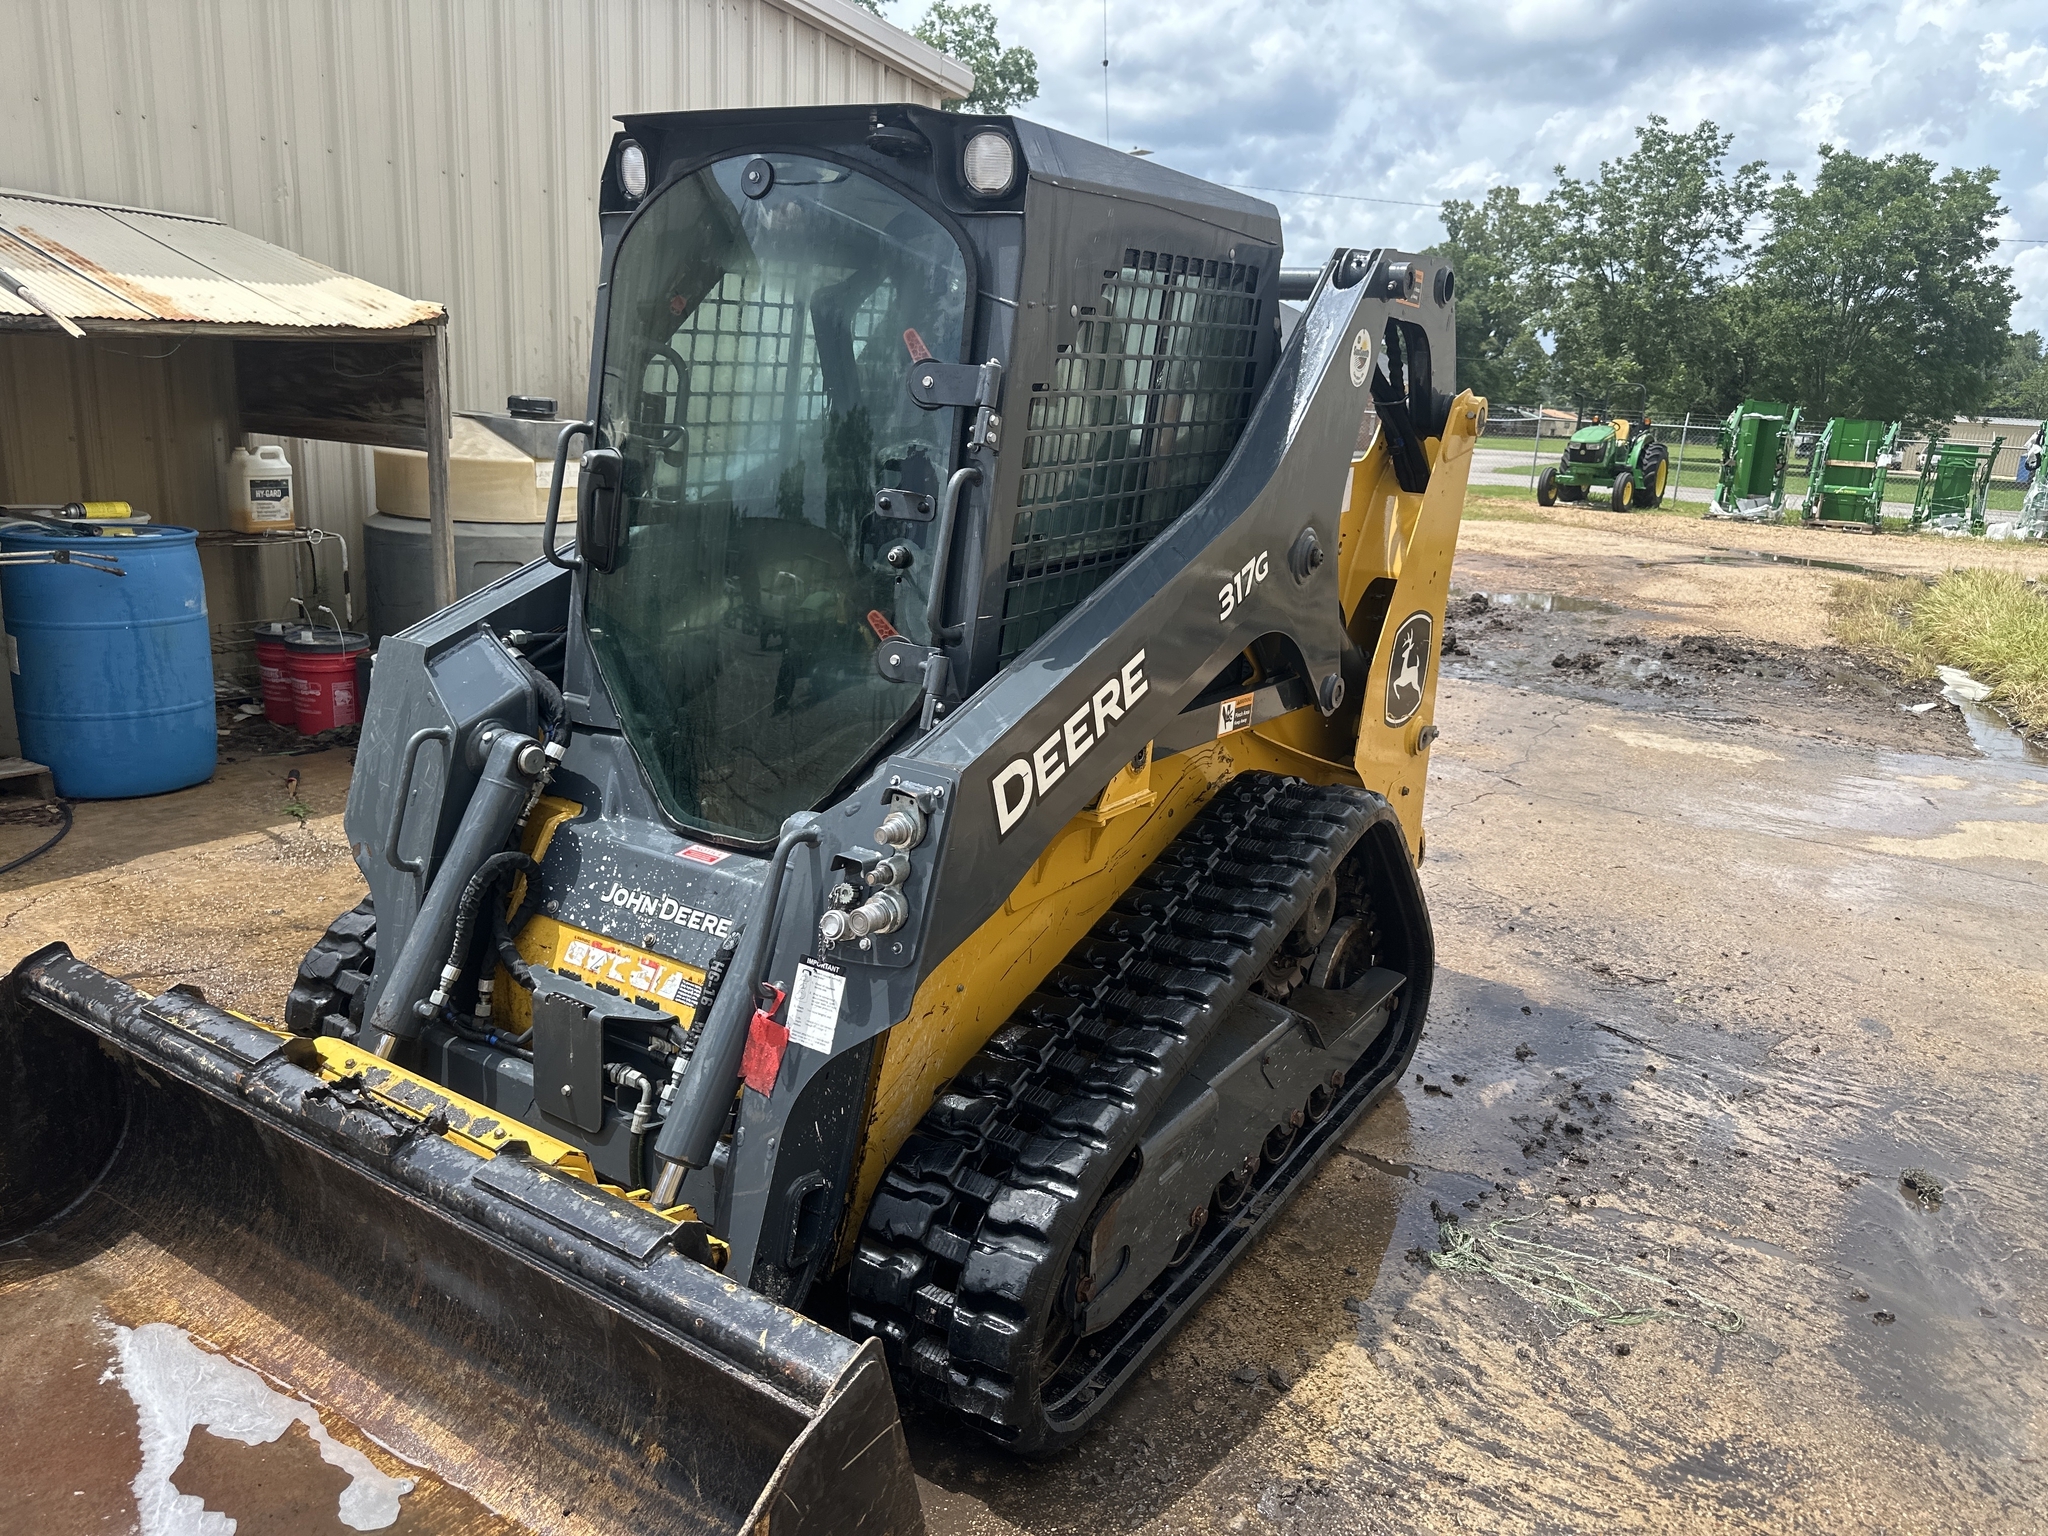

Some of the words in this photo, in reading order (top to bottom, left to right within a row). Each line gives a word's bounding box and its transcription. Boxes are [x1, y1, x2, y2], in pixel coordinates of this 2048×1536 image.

[255, 489, 282, 498] HY-GARD
[1218, 550, 1269, 621] 317G
[992, 648, 1149, 836] DEERE
[600, 881, 659, 916] JOHN
[659, 897, 733, 938] DEERE
[700, 960, 725, 1007] HG-16
[806, 957, 841, 973] IMPORTANT
